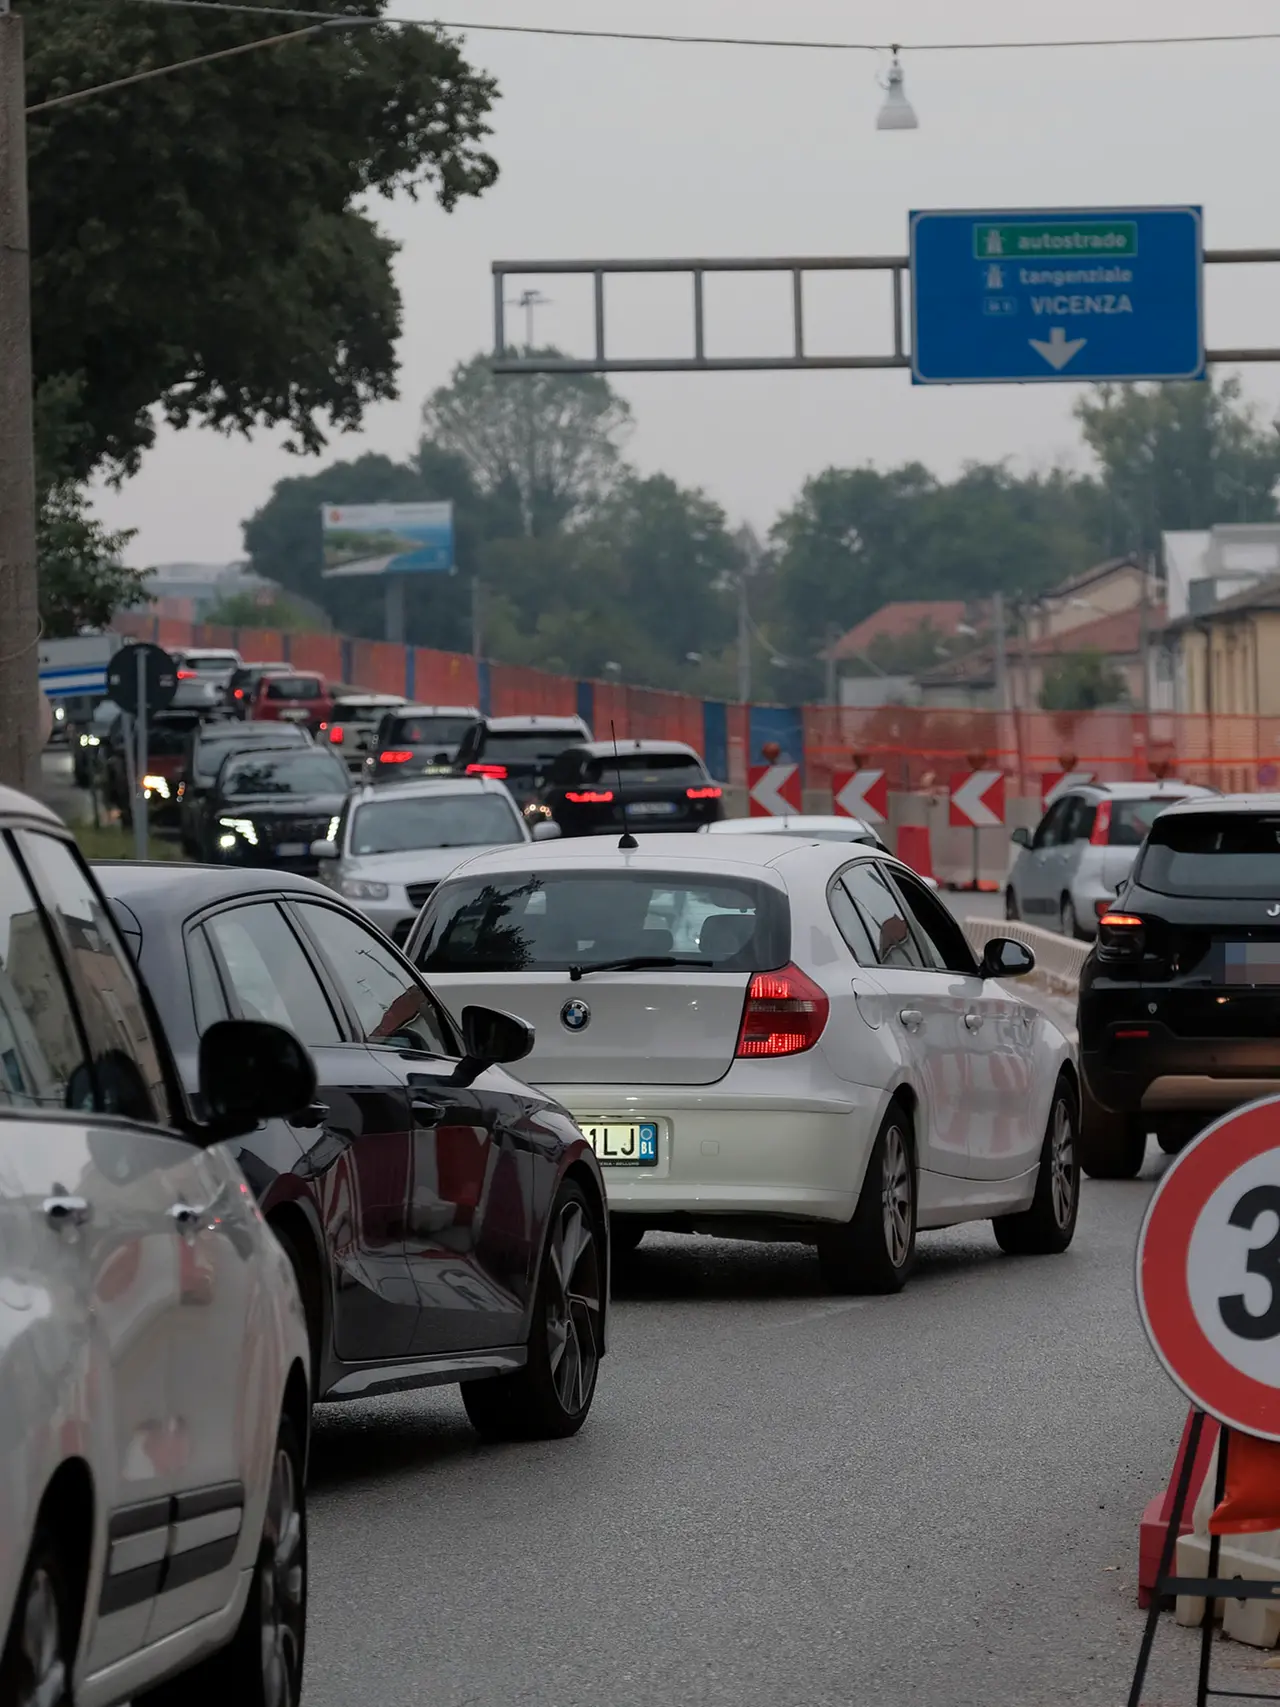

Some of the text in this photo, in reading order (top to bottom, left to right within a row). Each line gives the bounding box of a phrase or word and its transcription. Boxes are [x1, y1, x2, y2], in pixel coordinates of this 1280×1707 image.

[1019, 265, 1133, 287] tangenziale
[1030, 294, 1133, 316] VICENZA
[580, 1128, 634, 1156] 1LJ
[641, 1141, 654, 1154] BL
